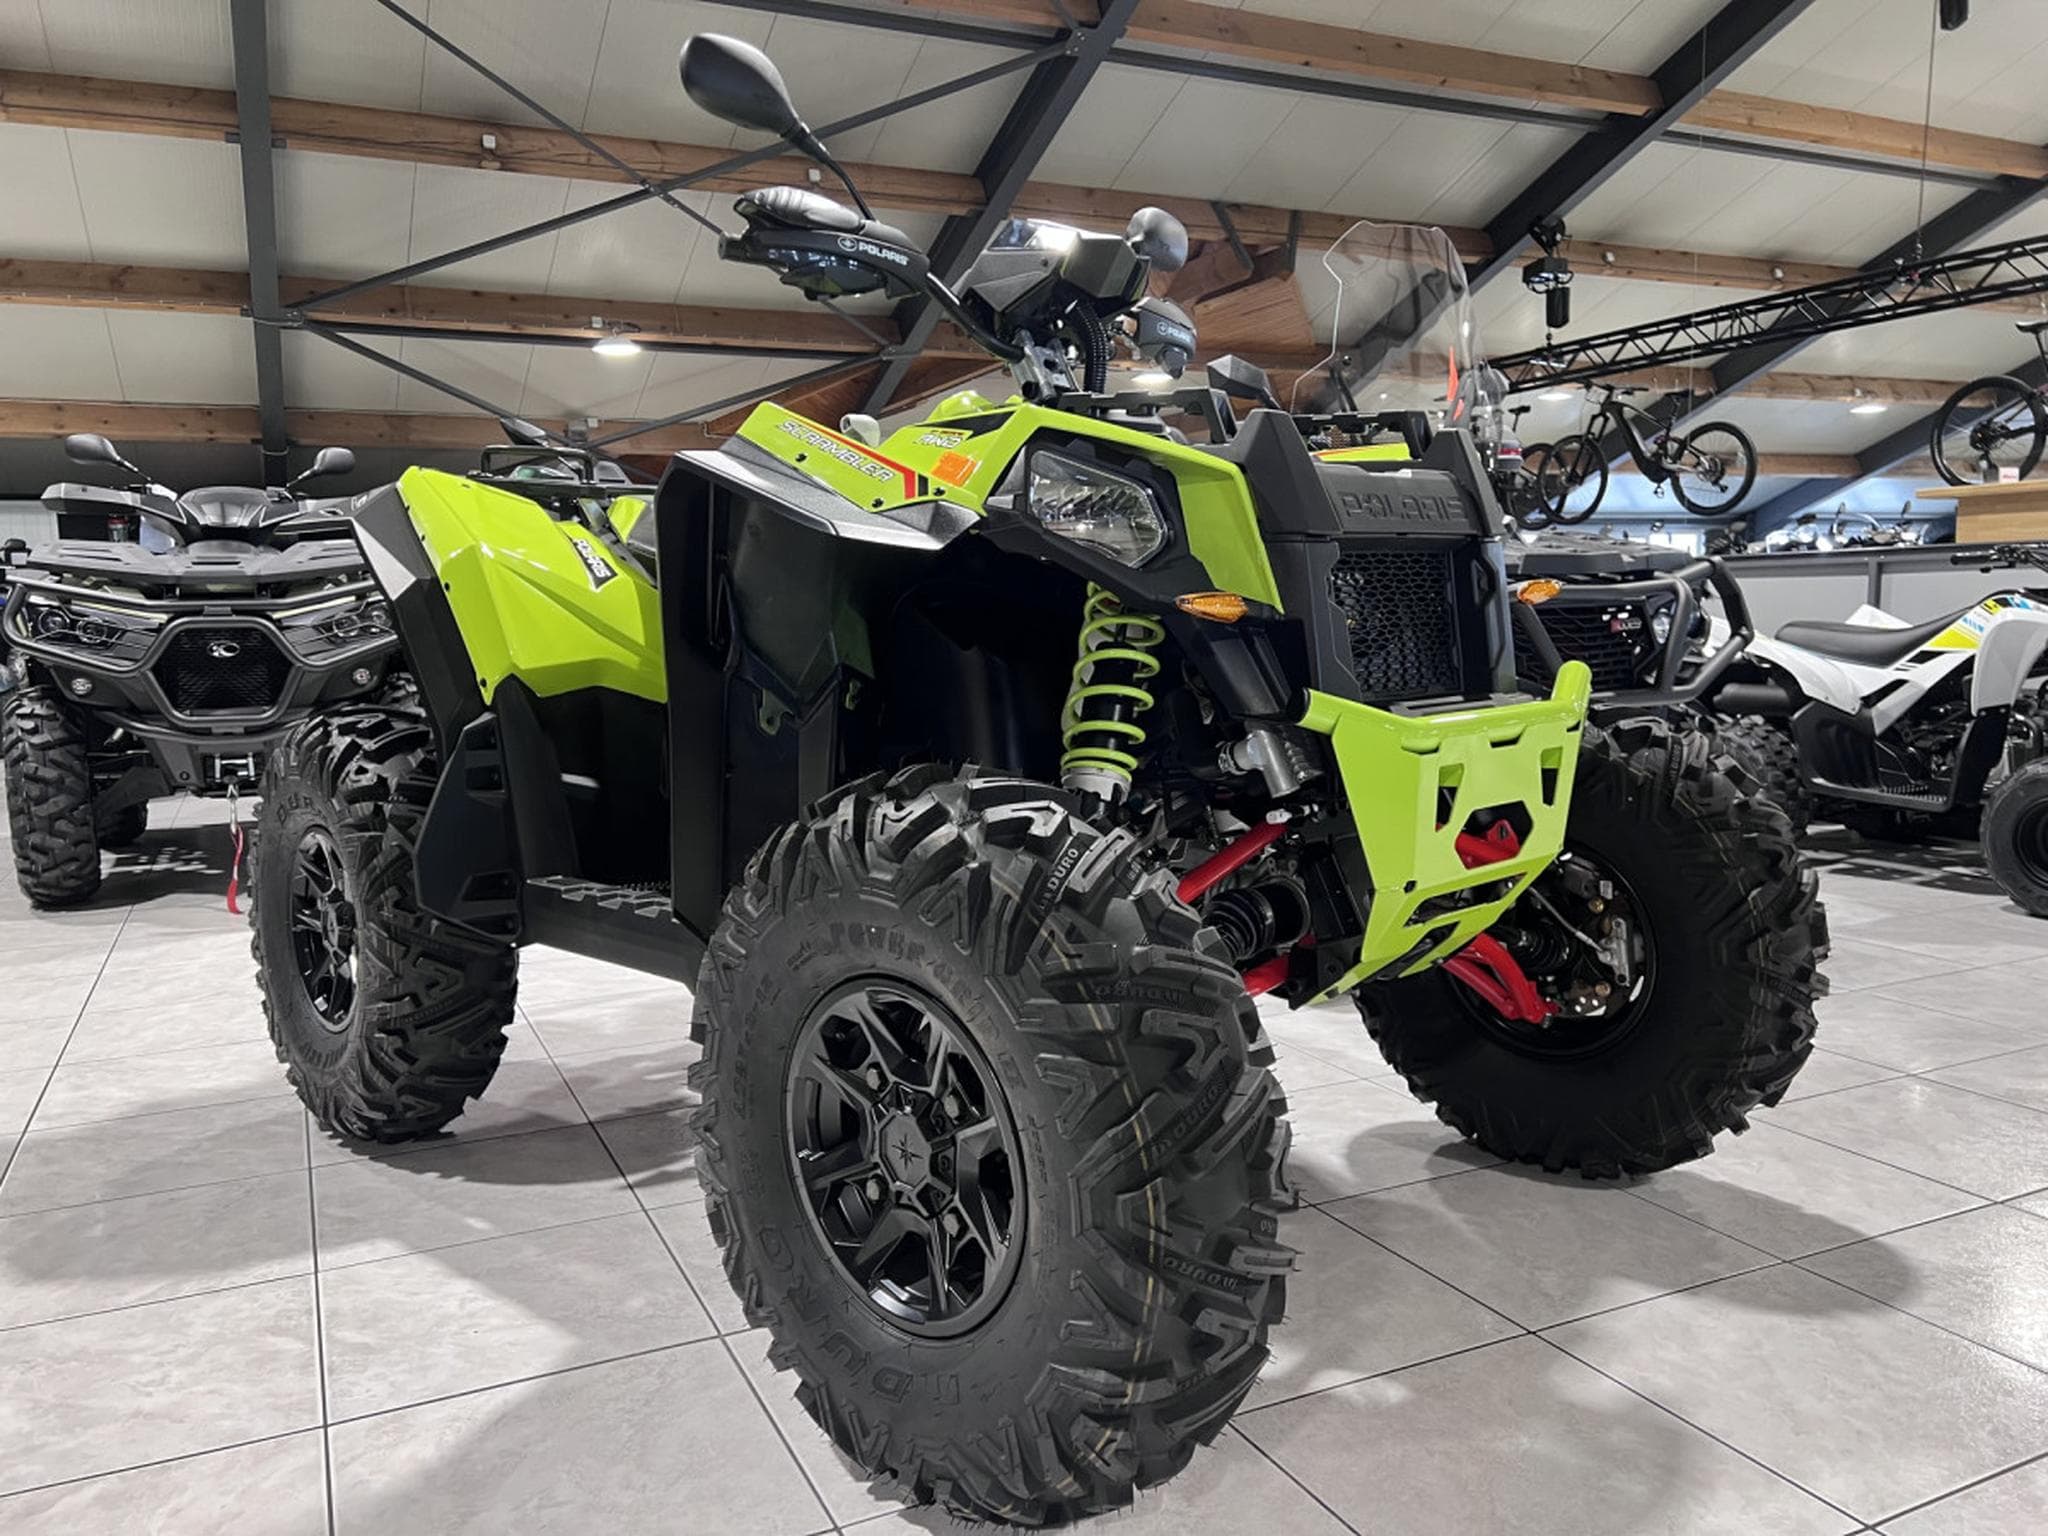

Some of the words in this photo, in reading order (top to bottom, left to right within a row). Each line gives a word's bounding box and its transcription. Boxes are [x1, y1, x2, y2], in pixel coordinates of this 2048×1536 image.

[859, 240, 910, 266] POLARIS
[778, 417, 896, 483] SCRAMBLER
[1338, 491, 1468, 521] POLARIS
[574, 539, 612, 578] POLARIS
[1047, 848, 1079, 890] DURO
